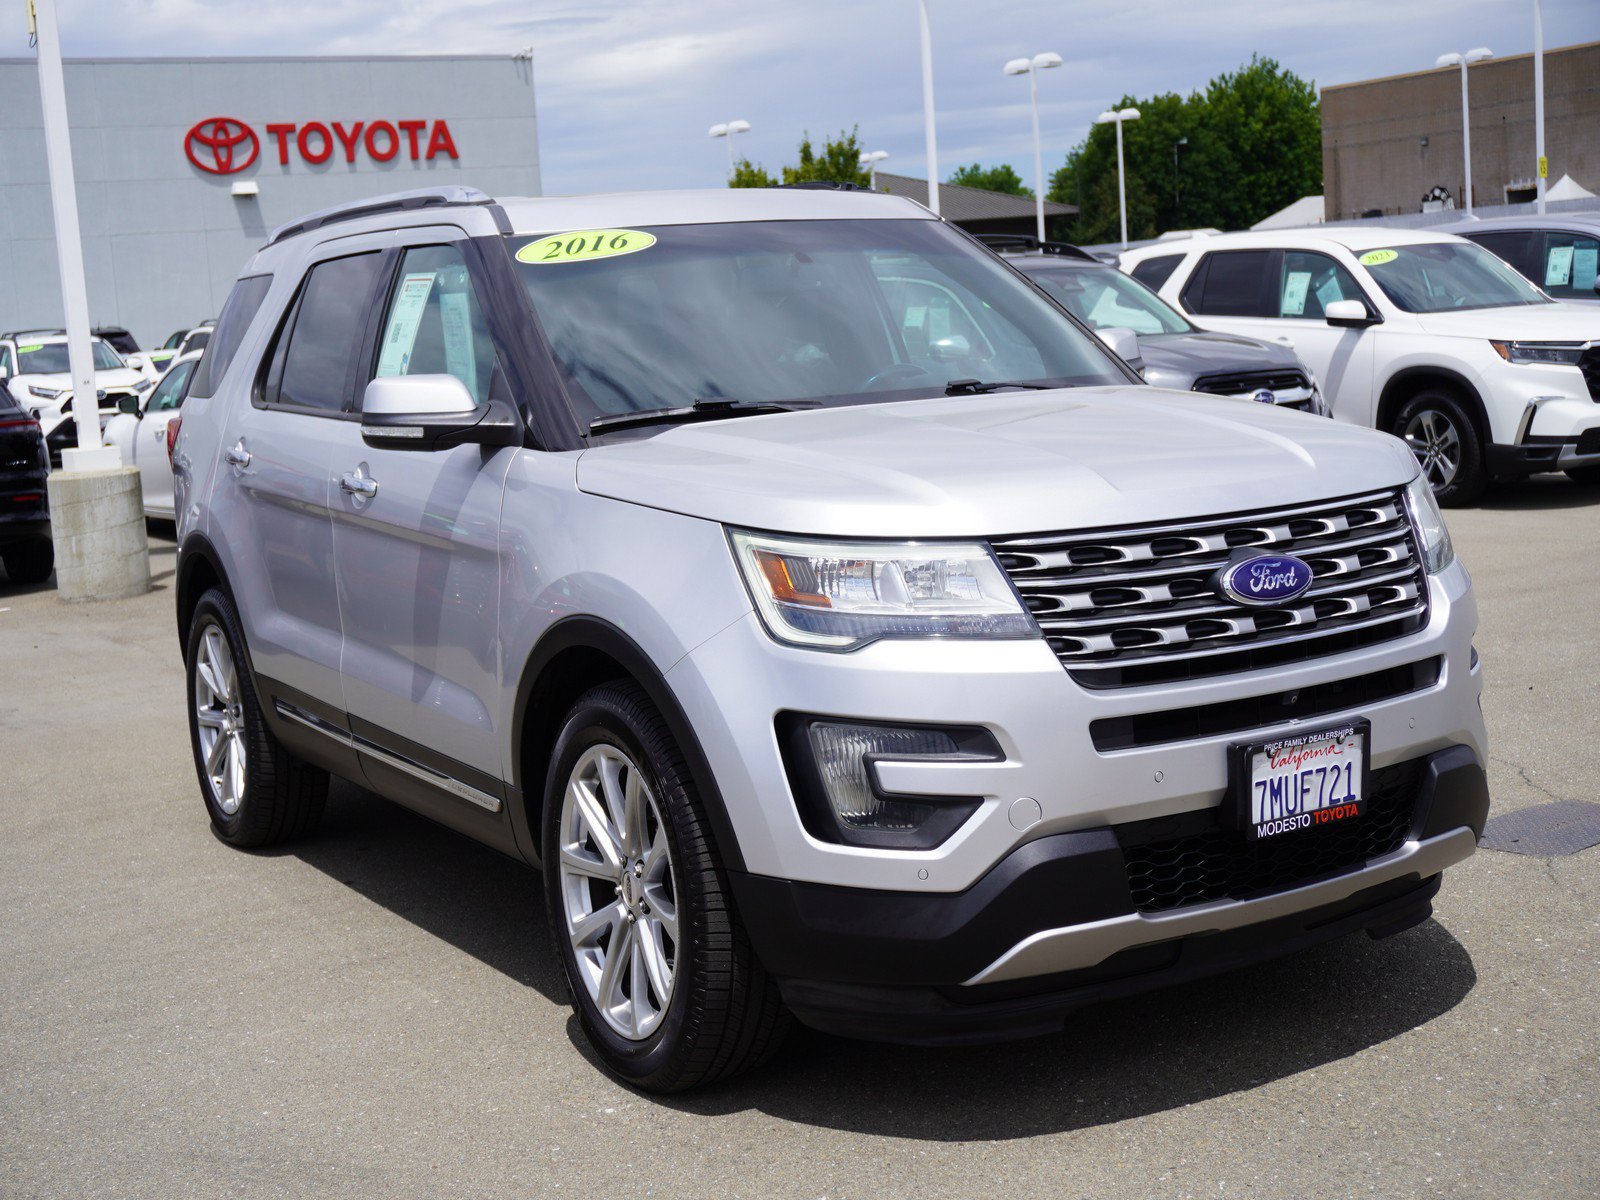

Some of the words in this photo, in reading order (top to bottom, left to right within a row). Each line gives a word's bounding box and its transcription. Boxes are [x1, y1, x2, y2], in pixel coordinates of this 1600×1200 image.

[266, 119, 459, 165] TOYOTA
[541, 232, 630, 260] 2016
[1249, 561, 1298, 593] Ford
[1264, 741, 1282, 752] PRICE
[1283, 737, 1308, 748] FAMILY
[1308, 728, 1354, 743] DEALERSHIPS
[1270, 741, 1343, 770] California
[1255, 761, 1356, 822] 7MUF721
[1257, 813, 1311, 838] MODESTO
[1313, 804, 1358, 824] TOYOTA
